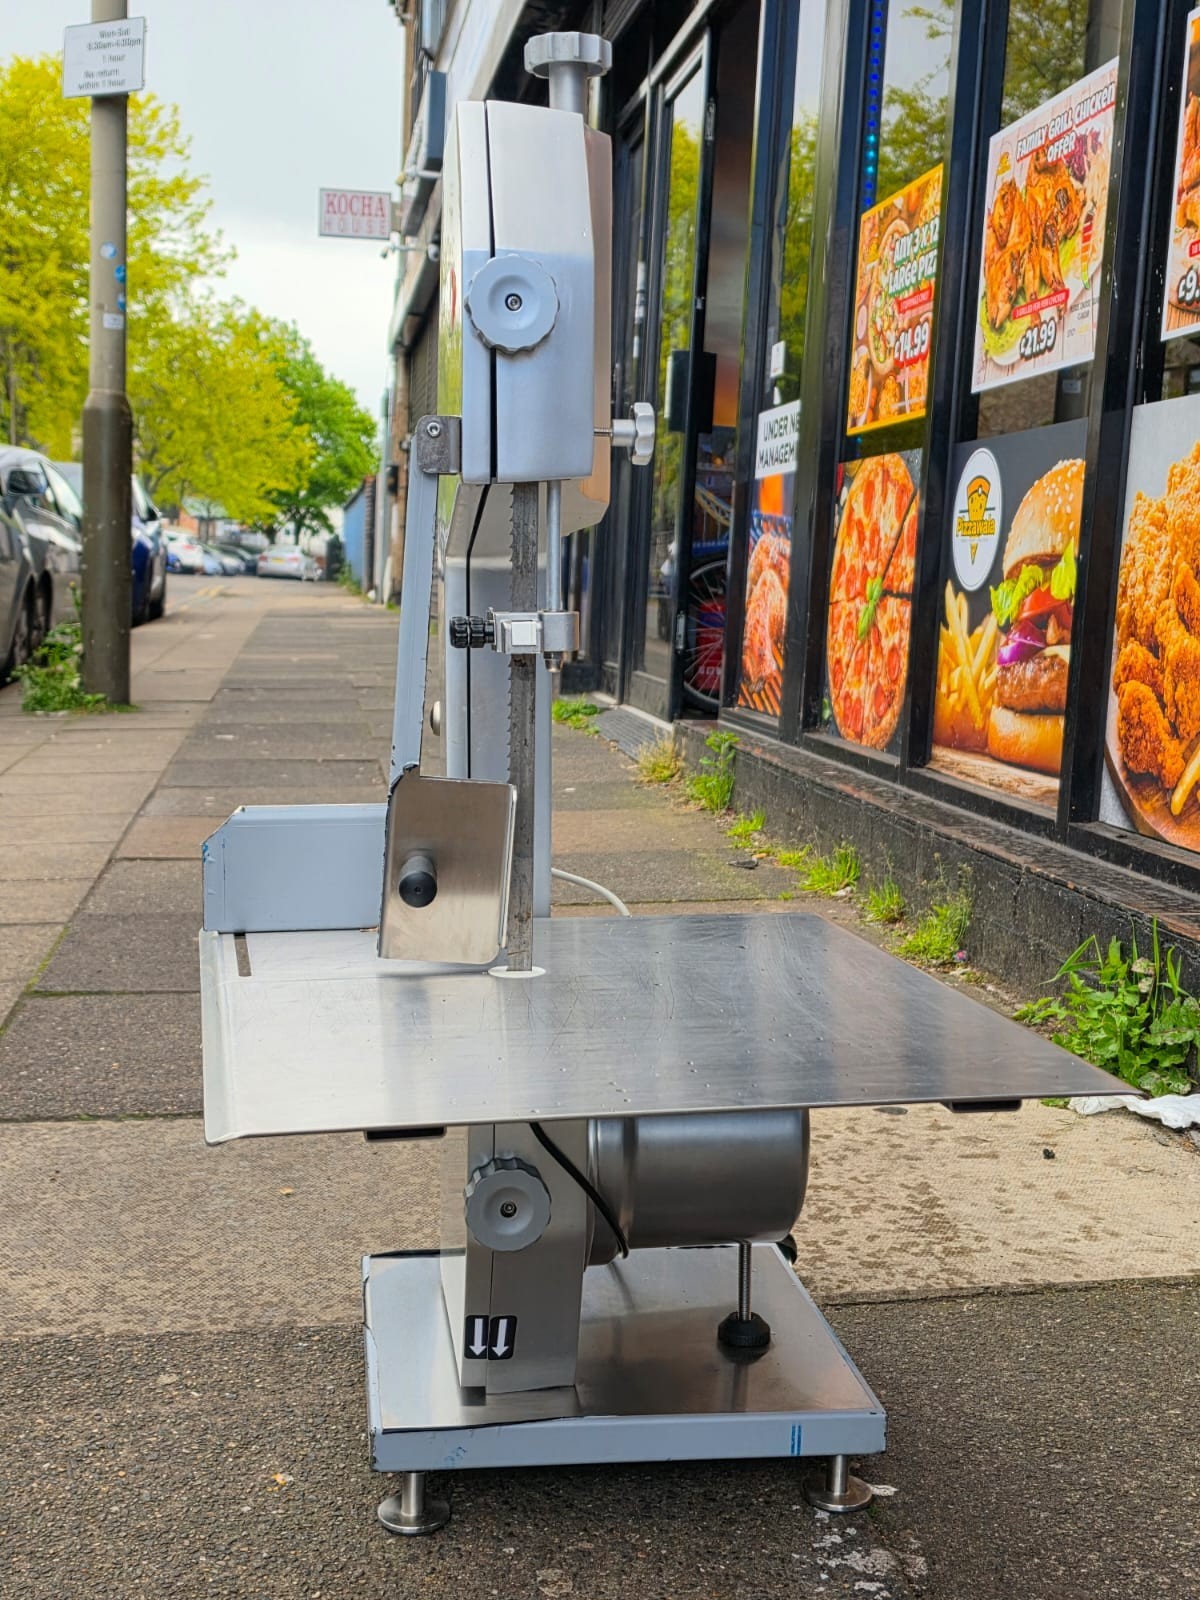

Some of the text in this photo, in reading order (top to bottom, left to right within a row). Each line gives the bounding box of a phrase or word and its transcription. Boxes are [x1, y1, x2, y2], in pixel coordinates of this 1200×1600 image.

[1016, 124, 1048, 162] FAMILY
[1047, 107, 1073, 143] GRILL
[325, 192, 385, 217] KOCHA
[912, 226, 921, 256] 3
[894, 320, 929, 367] £14.99
[1020, 316, 1057, 360] £21.99
[763, 416, 788, 442] UNDER
